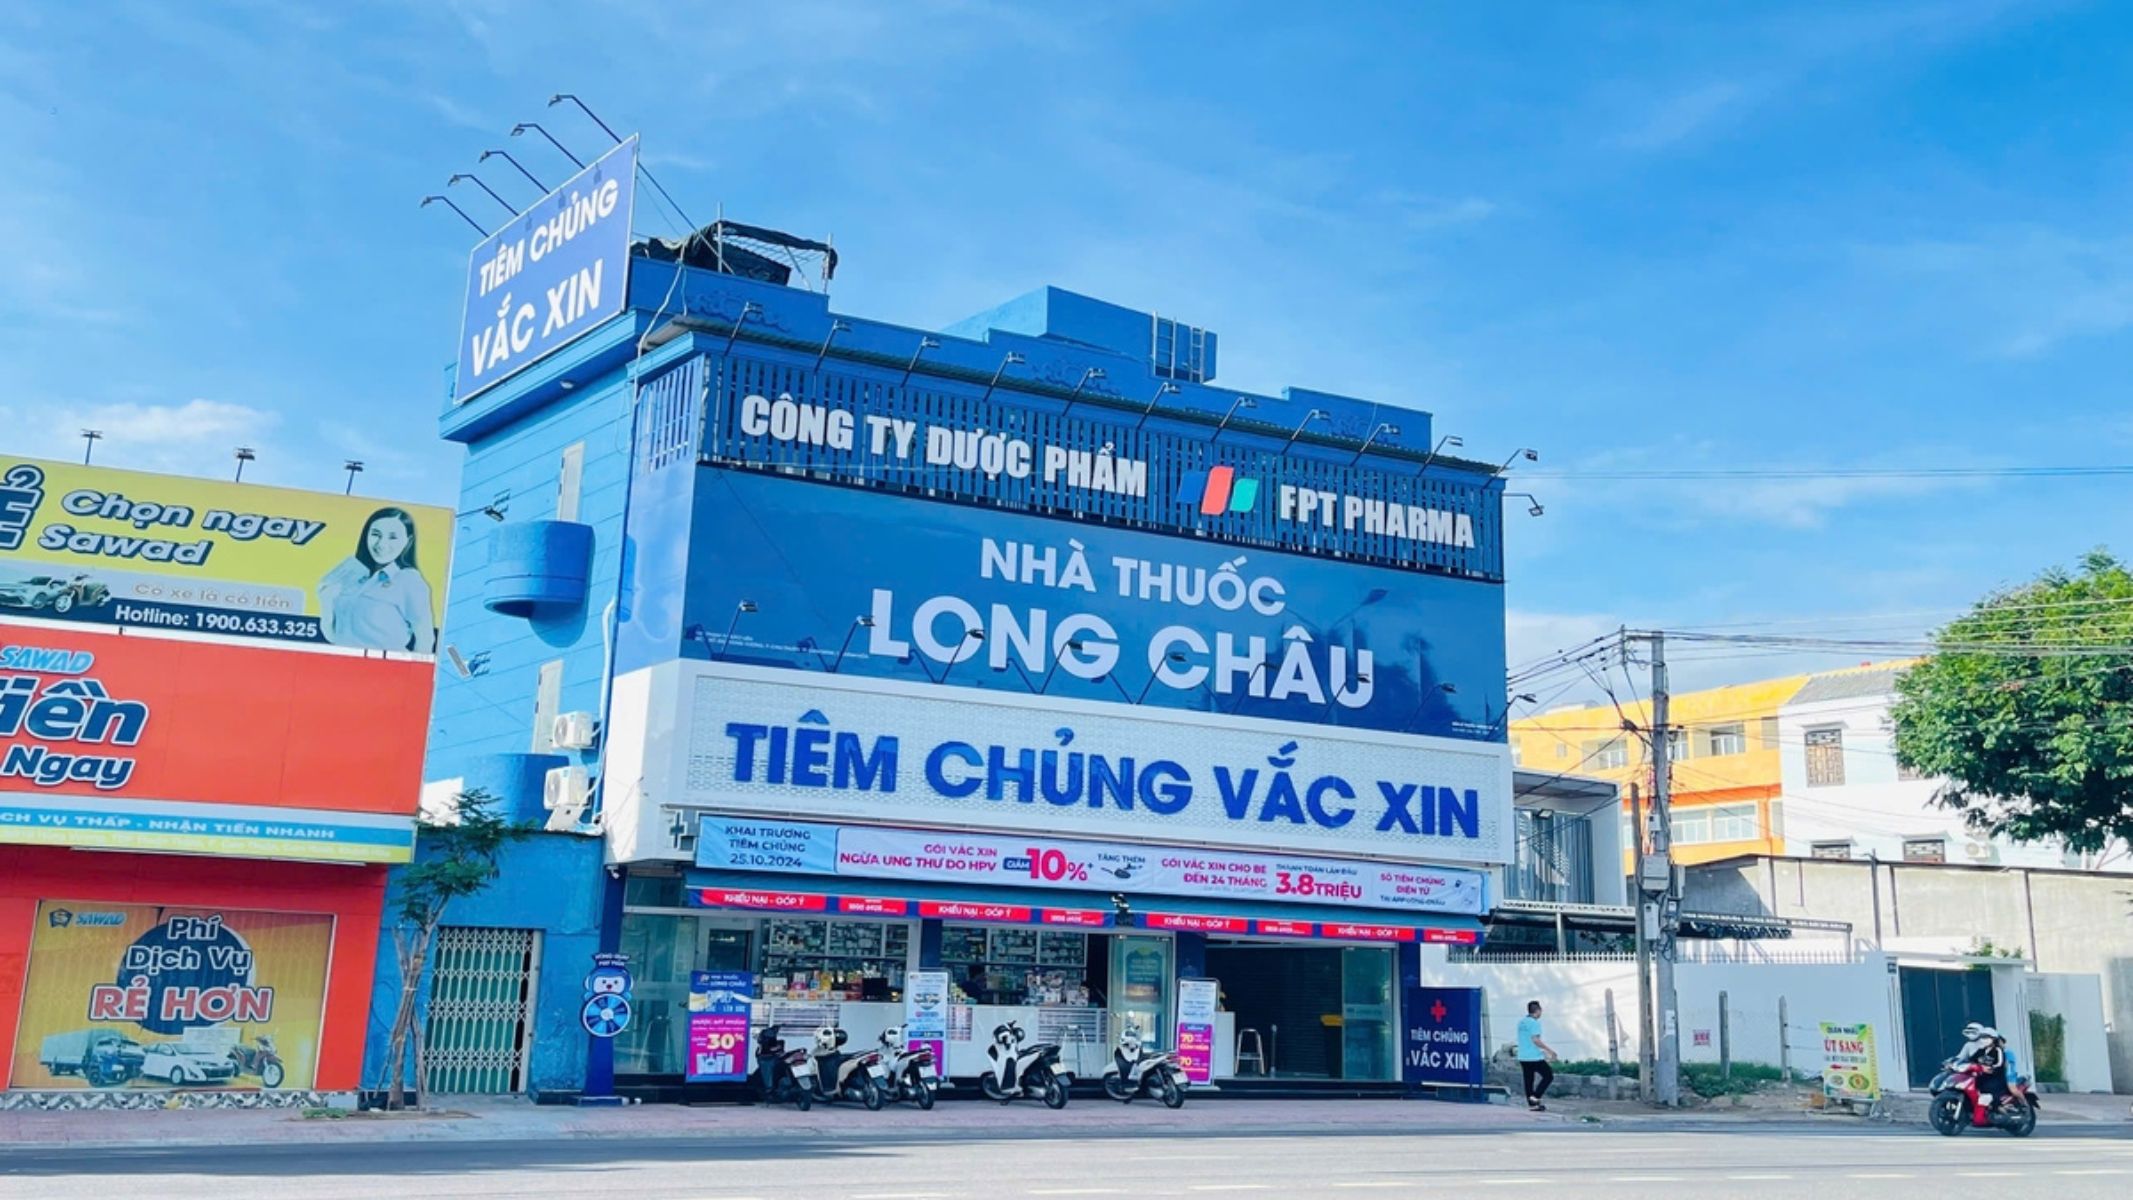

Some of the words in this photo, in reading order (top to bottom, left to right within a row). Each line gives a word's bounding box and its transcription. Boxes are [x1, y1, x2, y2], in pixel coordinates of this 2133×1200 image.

[480, 239, 525, 297] TIÊM
[530, 179, 618, 262] CHỦNG
[472, 292, 535, 376] VẮC
[542, 258, 603, 338] XIN
[741, 392, 853, 451] CÔNG
[866, 415, 917, 459] TY
[927, 428, 1030, 481] DƯỢC
[1044, 442, 1146, 497] PHẨM
[61, 489, 192, 530] Chọn
[202, 509, 326, 545] ngay
[1280, 484, 1337, 527] FPT
[1344, 495, 1475, 548] PHARMA
[38, 524, 213, 565] Sawad
[980, 538, 1096, 592] NHÀ
[1112, 555, 1286, 616] THUỐC
[170, 588, 193, 598] xe
[115, 605, 189, 627] Hotline:
[196, 612, 317, 638] 1900.633.325
[0, 645, 94, 675] SAWAD
[869, 588, 1120, 679] LONG
[1148, 625, 1374, 708] CHÂU
[0, 676, 149, 745] iền
[0, 744, 136, 789] Ngay
[726, 709, 898, 792] TIÊM
[925, 727, 1193, 815] CHỦNG
[1213, 740, 1357, 830] VẮC
[1375, 781, 1479, 838] XIN
[265, 827, 335, 839] NHANH
[725, 826, 756, 837] KHAI
[729, 838, 759, 849] TIÊM
[730, 853, 802, 867] 25.10.2024
[883, 855, 912, 867] UNG
[915, 856, 944, 868] THƯ
[945, 858, 966, 870] DO
[968, 860, 997, 871] HPV
[977, 846, 997, 857] XIN
[1208, 861, 1226, 870] XIN
[1228, 863, 1251, 873] CHO
[1211, 875, 1225, 884] 24
[1275, 872, 1314, 895] 3.8
[1315, 881, 1362, 901] TRIỆU
[168, 914, 223, 939] Phí
[126, 946, 199, 974] Dịch
[207, 946, 251, 974] Vụ
[89, 976, 149, 1021] RẺ
[161, 984, 273, 1021] HƠN
[1410, 1027, 1431, 1041] TIÊM
[1432, 1028, 1469, 1044] CHỦNG
[1839, 1040, 1864, 1054] SANG
[1411, 1043, 1441, 1068] VẮC
[1444, 1053, 1469, 1070] XIN
